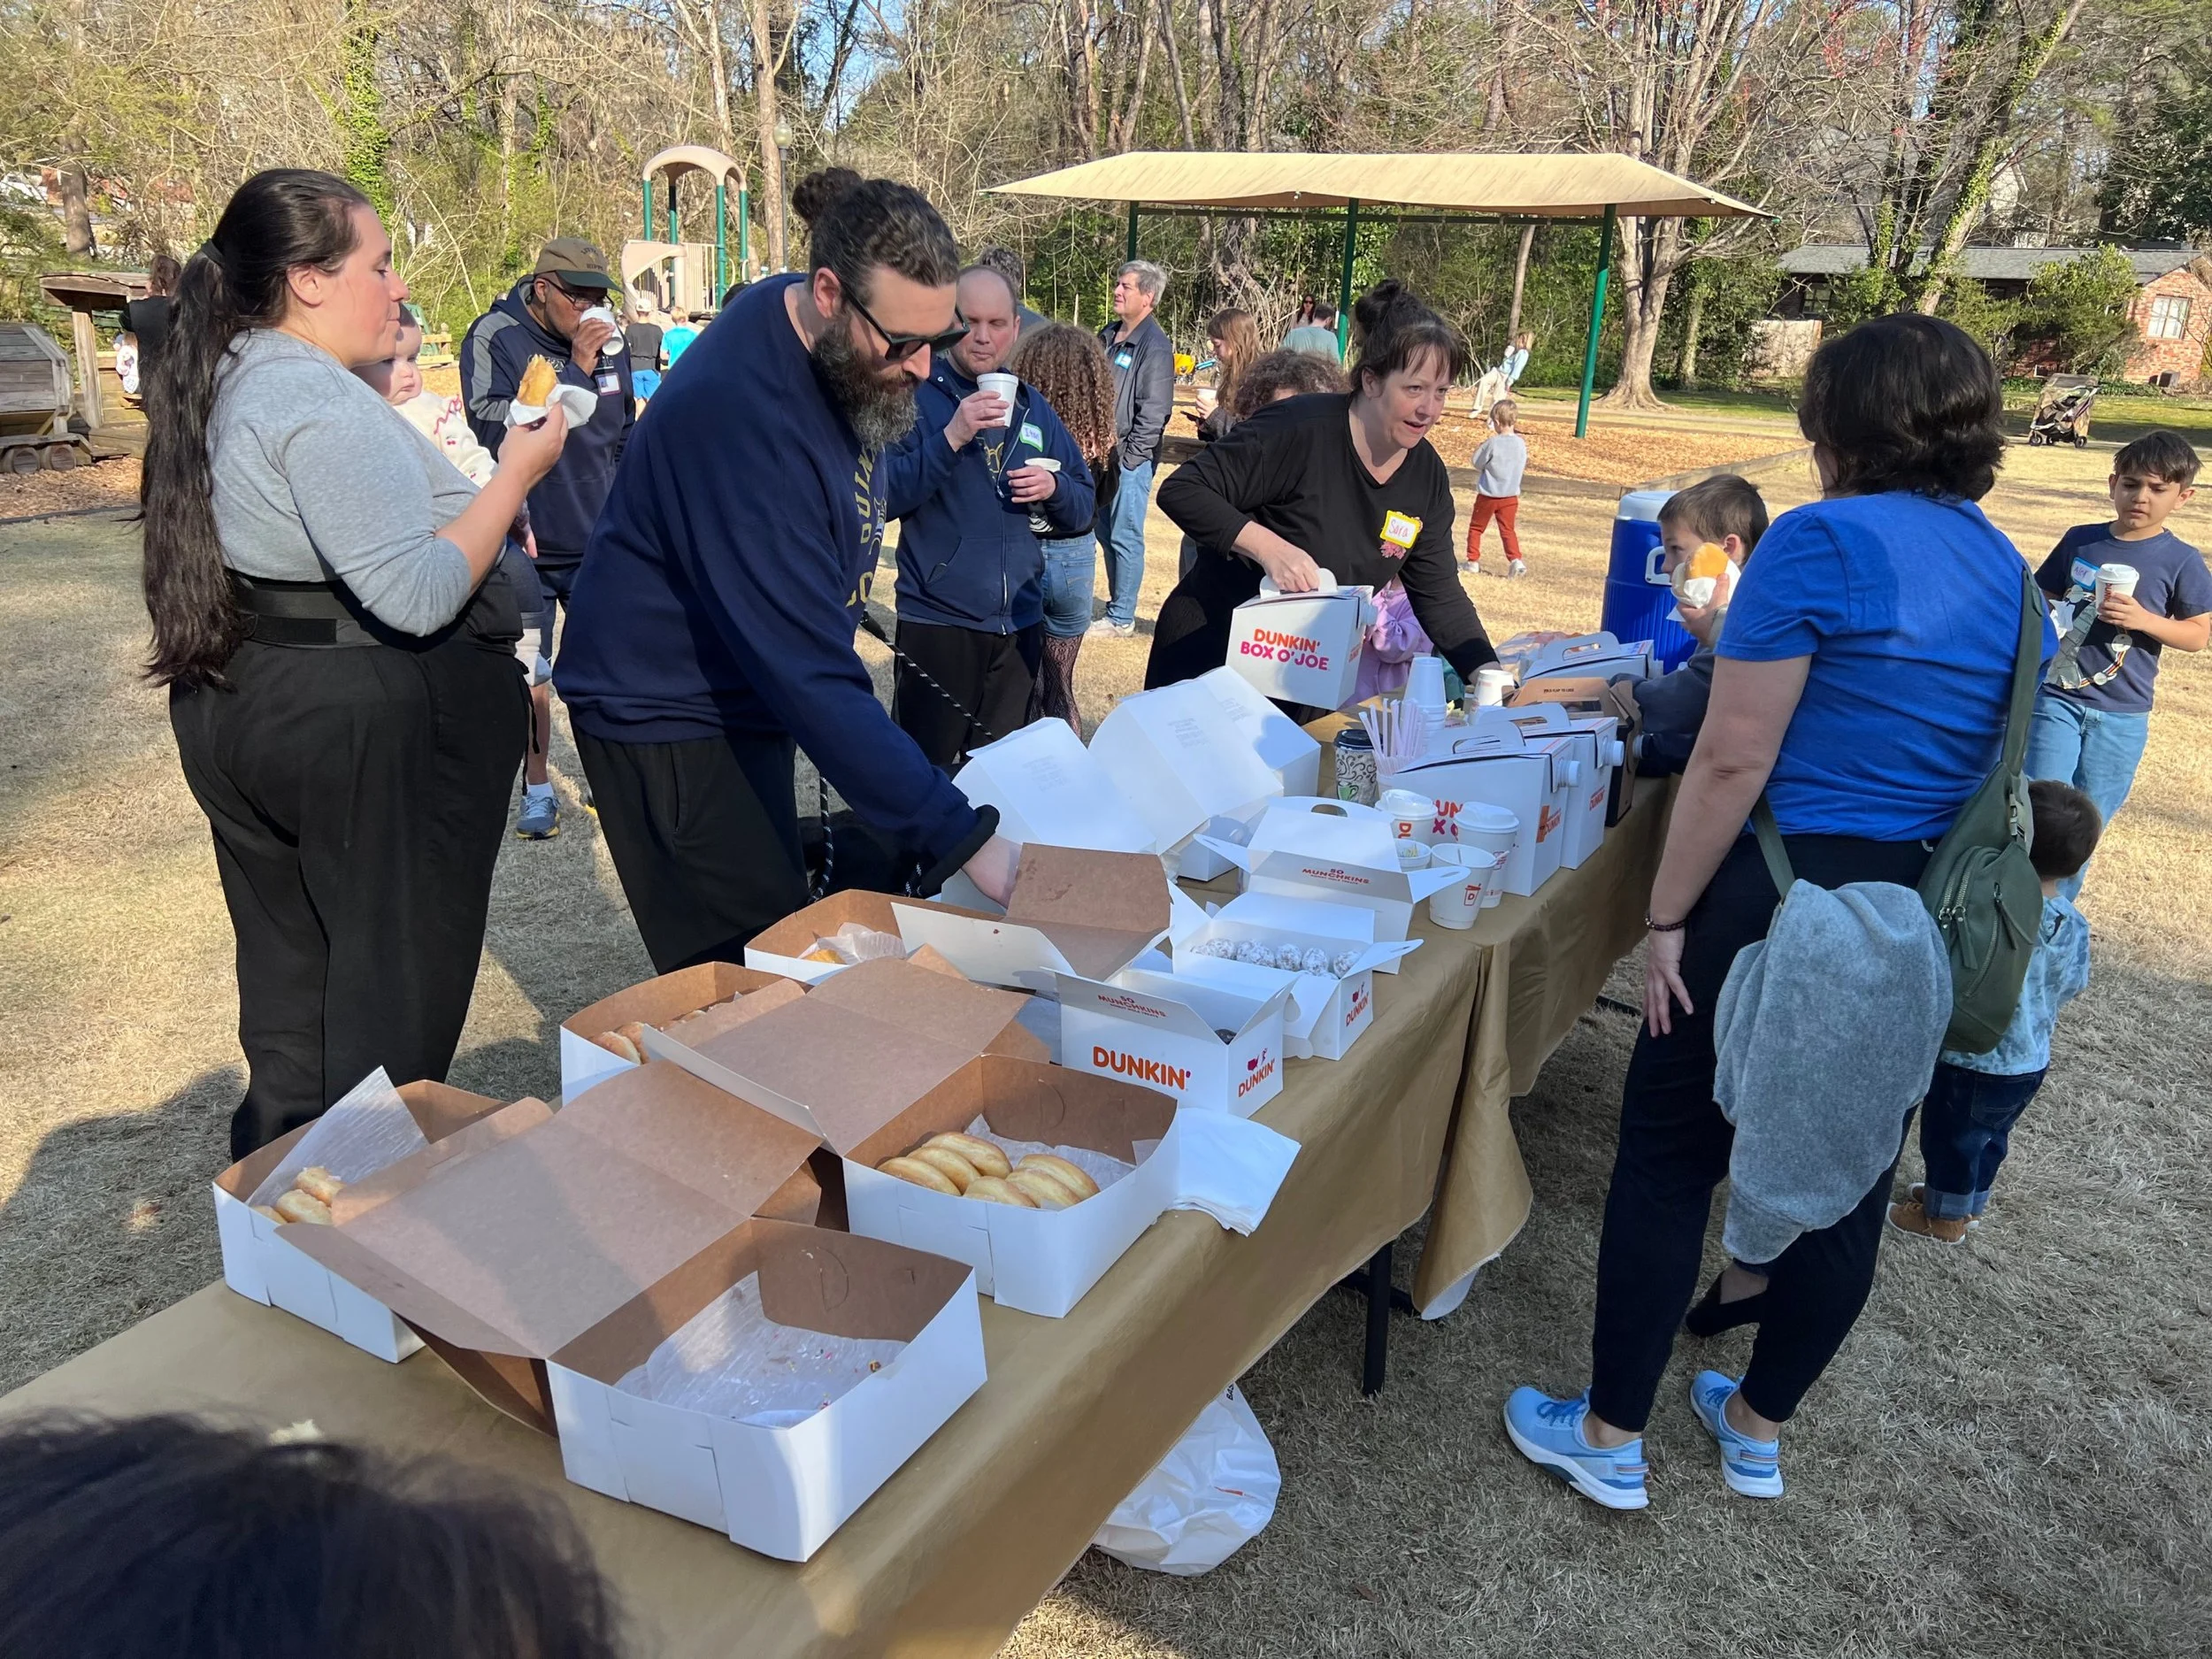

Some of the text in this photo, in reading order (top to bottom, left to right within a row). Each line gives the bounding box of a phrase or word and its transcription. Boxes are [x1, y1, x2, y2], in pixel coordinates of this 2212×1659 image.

[1240, 641, 1274, 660] BOX
[1254, 628, 1320, 653] DUNKIN'
[1302, 868, 1370, 884] MUNCHKINS
[1097, 995, 1166, 1018] MUNCHKINS
[1093, 1046, 1191, 1090] DUNKIN'
[1239, 1057, 1275, 1097] DUNKIN'
